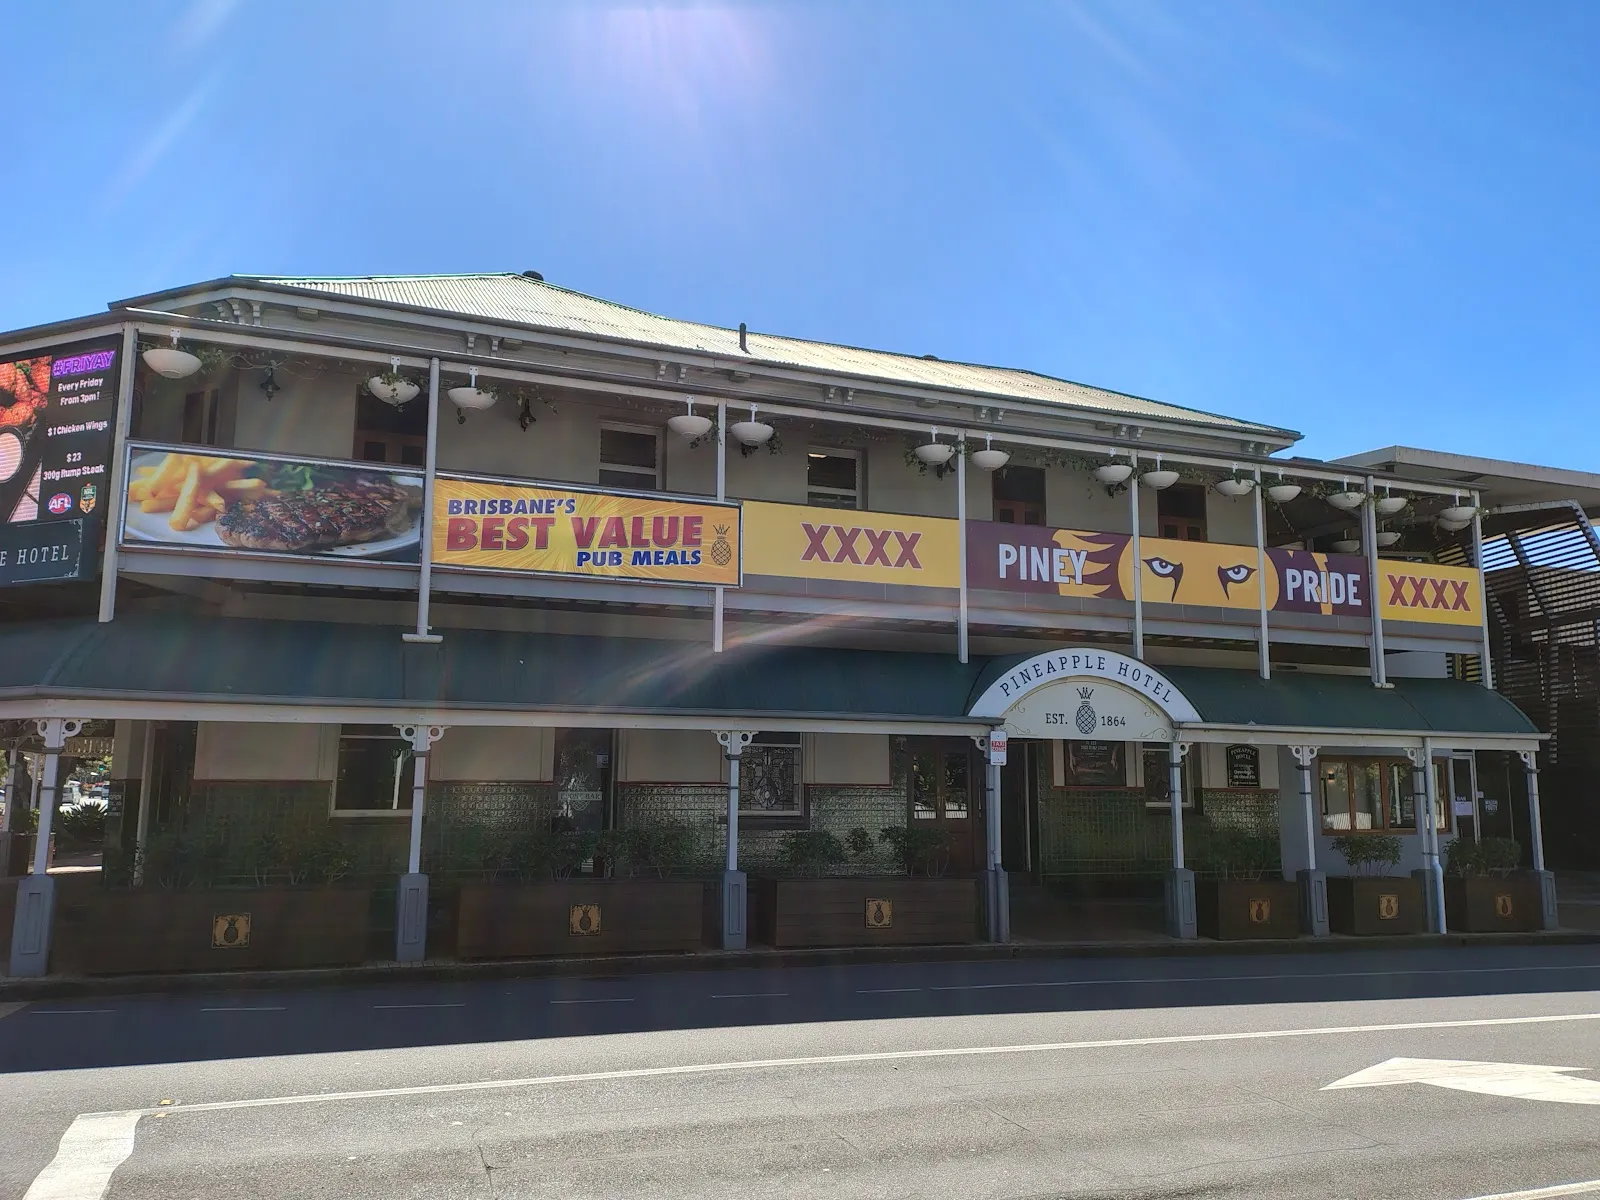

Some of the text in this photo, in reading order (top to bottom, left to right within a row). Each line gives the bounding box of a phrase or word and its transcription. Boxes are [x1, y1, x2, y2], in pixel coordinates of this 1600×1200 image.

[53, 350, 115, 376] #FRIYAY
[58, 377, 104, 392] Every Friday
[60, 394, 80, 406] From
[57, 424, 85, 435] Chicken
[86, 420, 108, 431] Wings
[43, 464, 105, 481] 300g Rump Steak
[49, 495, 72, 509] AFL
[447, 498, 576, 515] BRISBANE'S
[446, 515, 704, 551] BEST VALUE
[16, 544, 69, 565] HOTEL
[800, 522, 923, 570] XXXX
[576, 550, 701, 567] PUB MEALS
[998, 543, 1088, 585] PINEY
[1285, 568, 1362, 606] PRIDE
[1386, 573, 1473, 612] XXXX
[1000, 655, 1170, 703] PINEAPPLE HOTEL
[1045, 713, 1126, 727] EST. 1864
